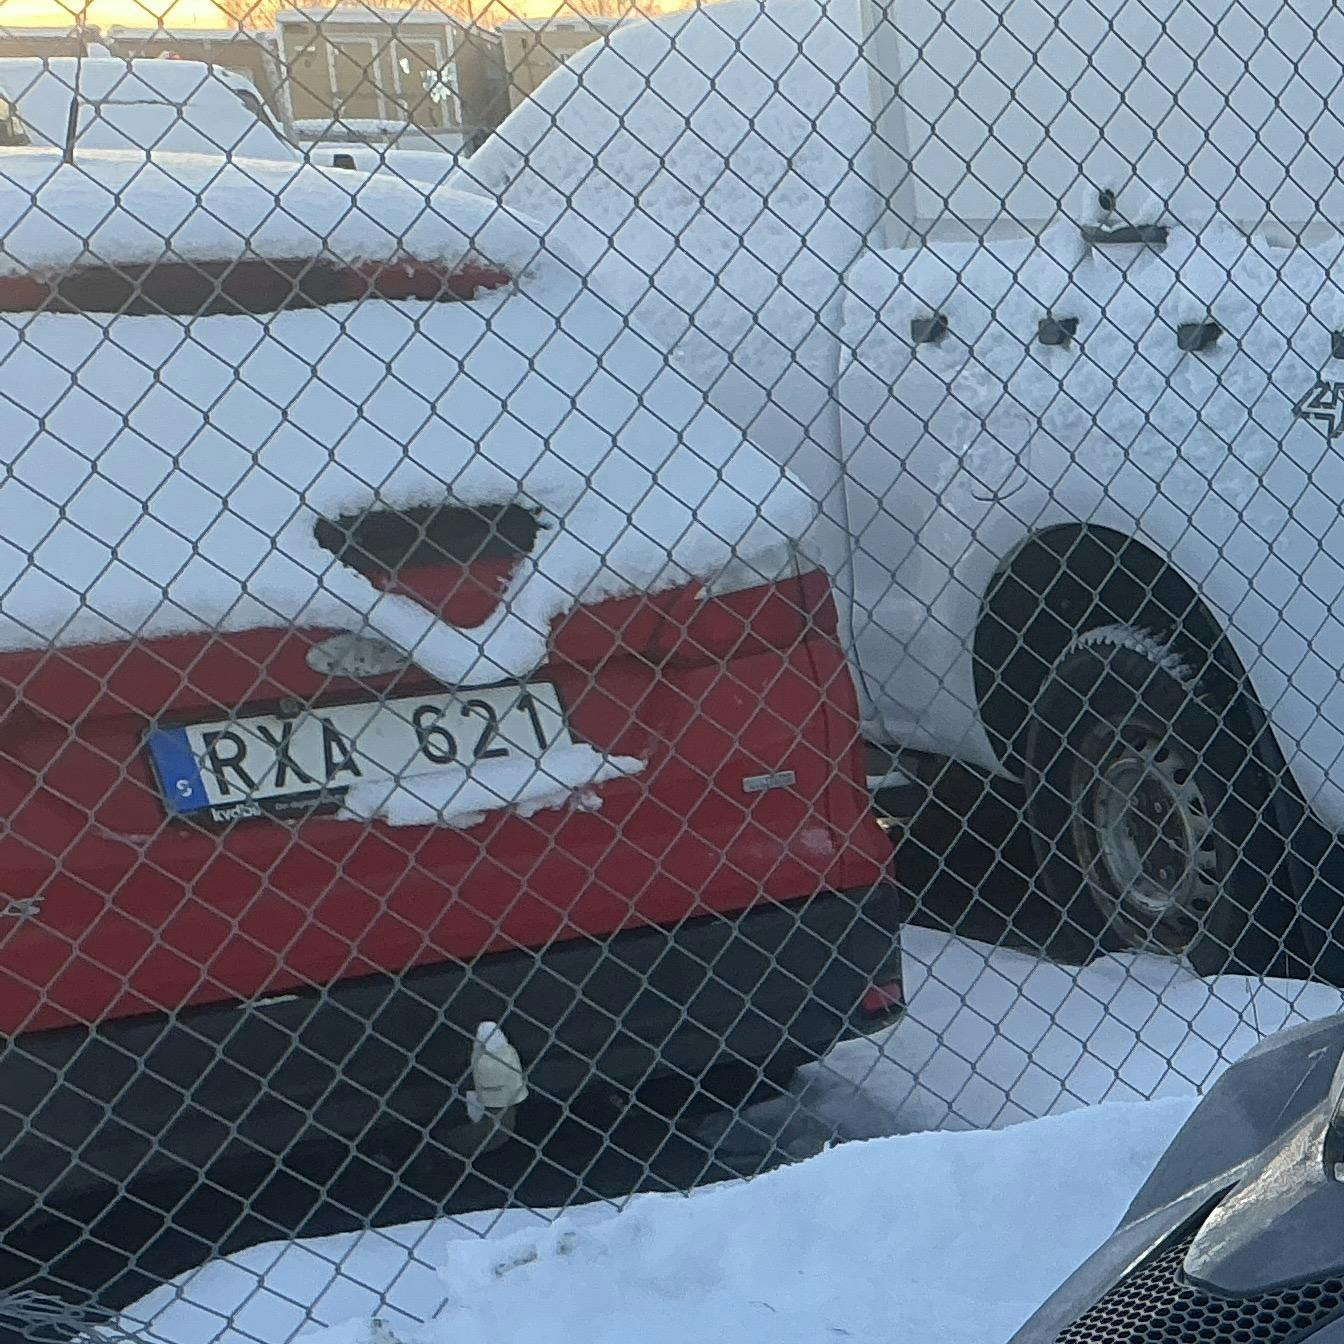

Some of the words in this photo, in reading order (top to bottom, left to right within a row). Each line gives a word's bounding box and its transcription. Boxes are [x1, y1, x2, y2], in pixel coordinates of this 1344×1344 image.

[203, 718, 361, 795] RXA
[412, 693, 547, 764] 621
[176, 779, 193, 797] S
